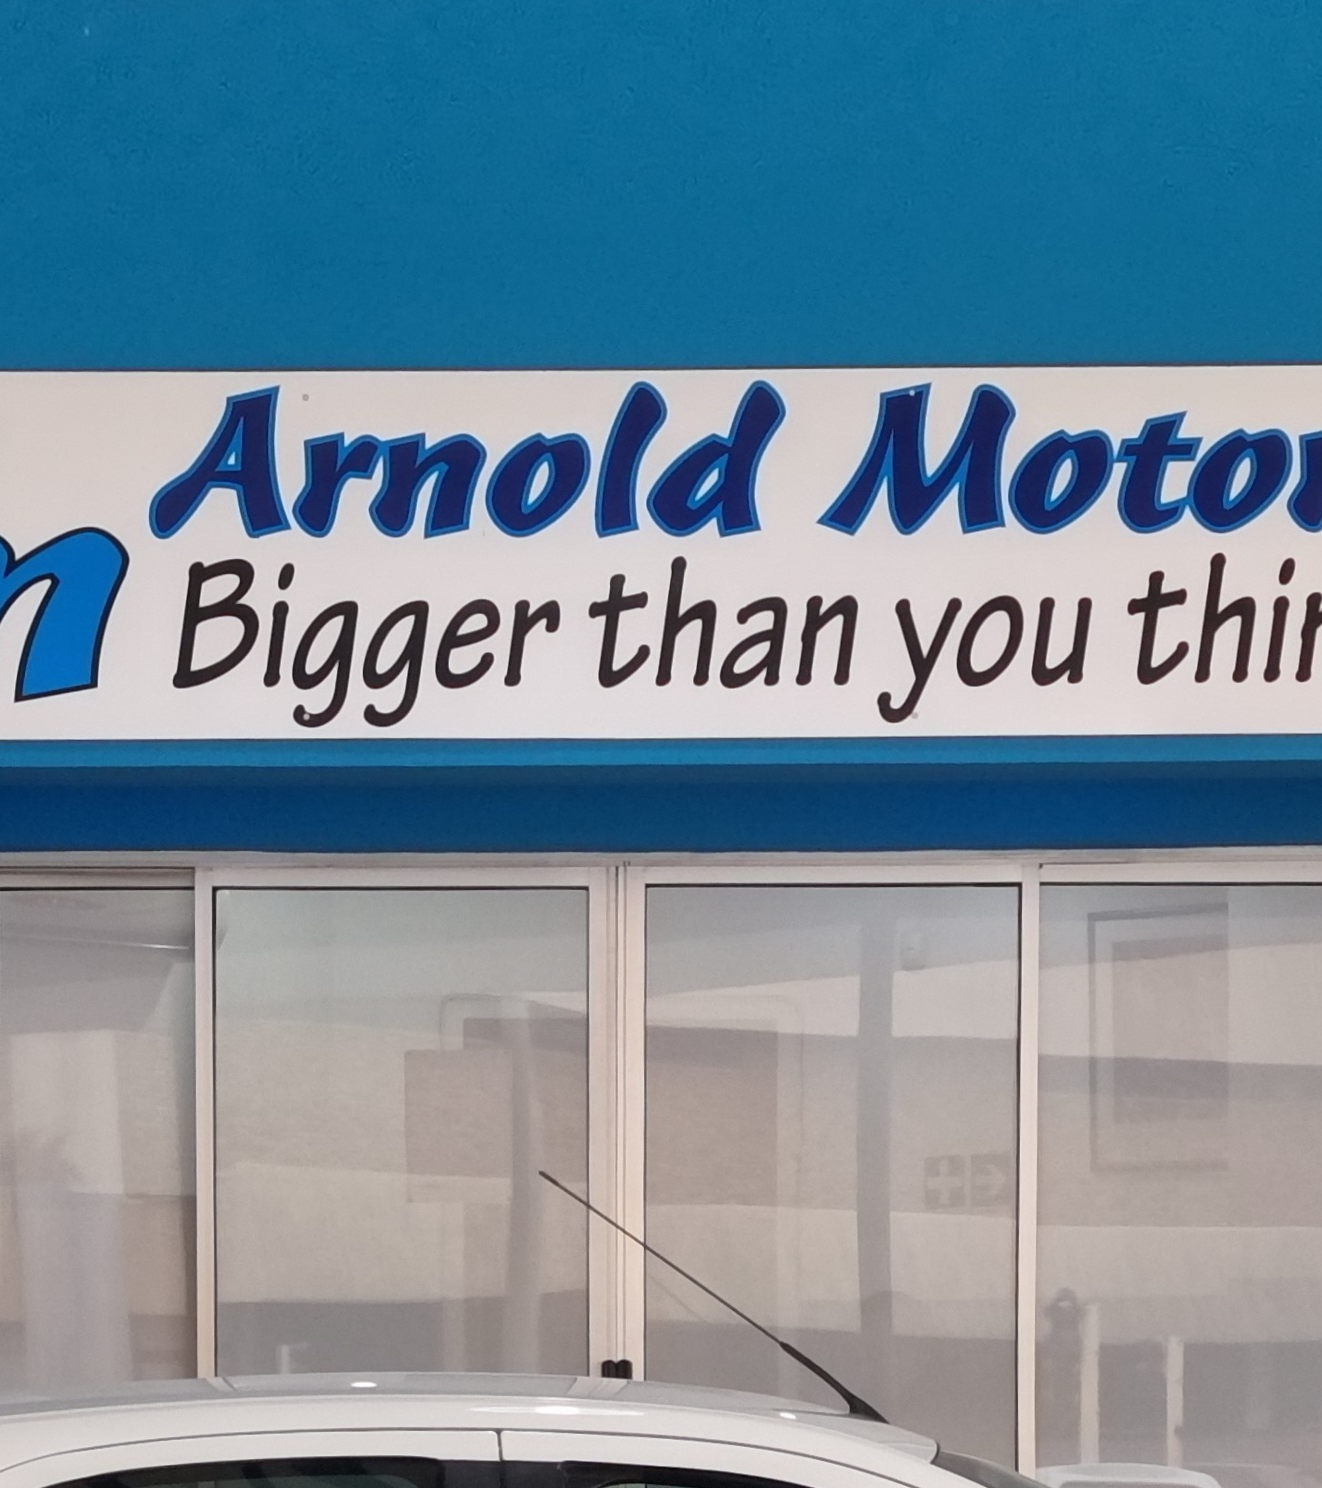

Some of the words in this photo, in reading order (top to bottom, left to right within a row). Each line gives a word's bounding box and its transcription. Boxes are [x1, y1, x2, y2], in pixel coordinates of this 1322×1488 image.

[149, 380, 786, 539] Arnold
[173, 559, 560, 728] Bigger
[588, 556, 859, 689] than
[876, 596, 1093, 723] you
